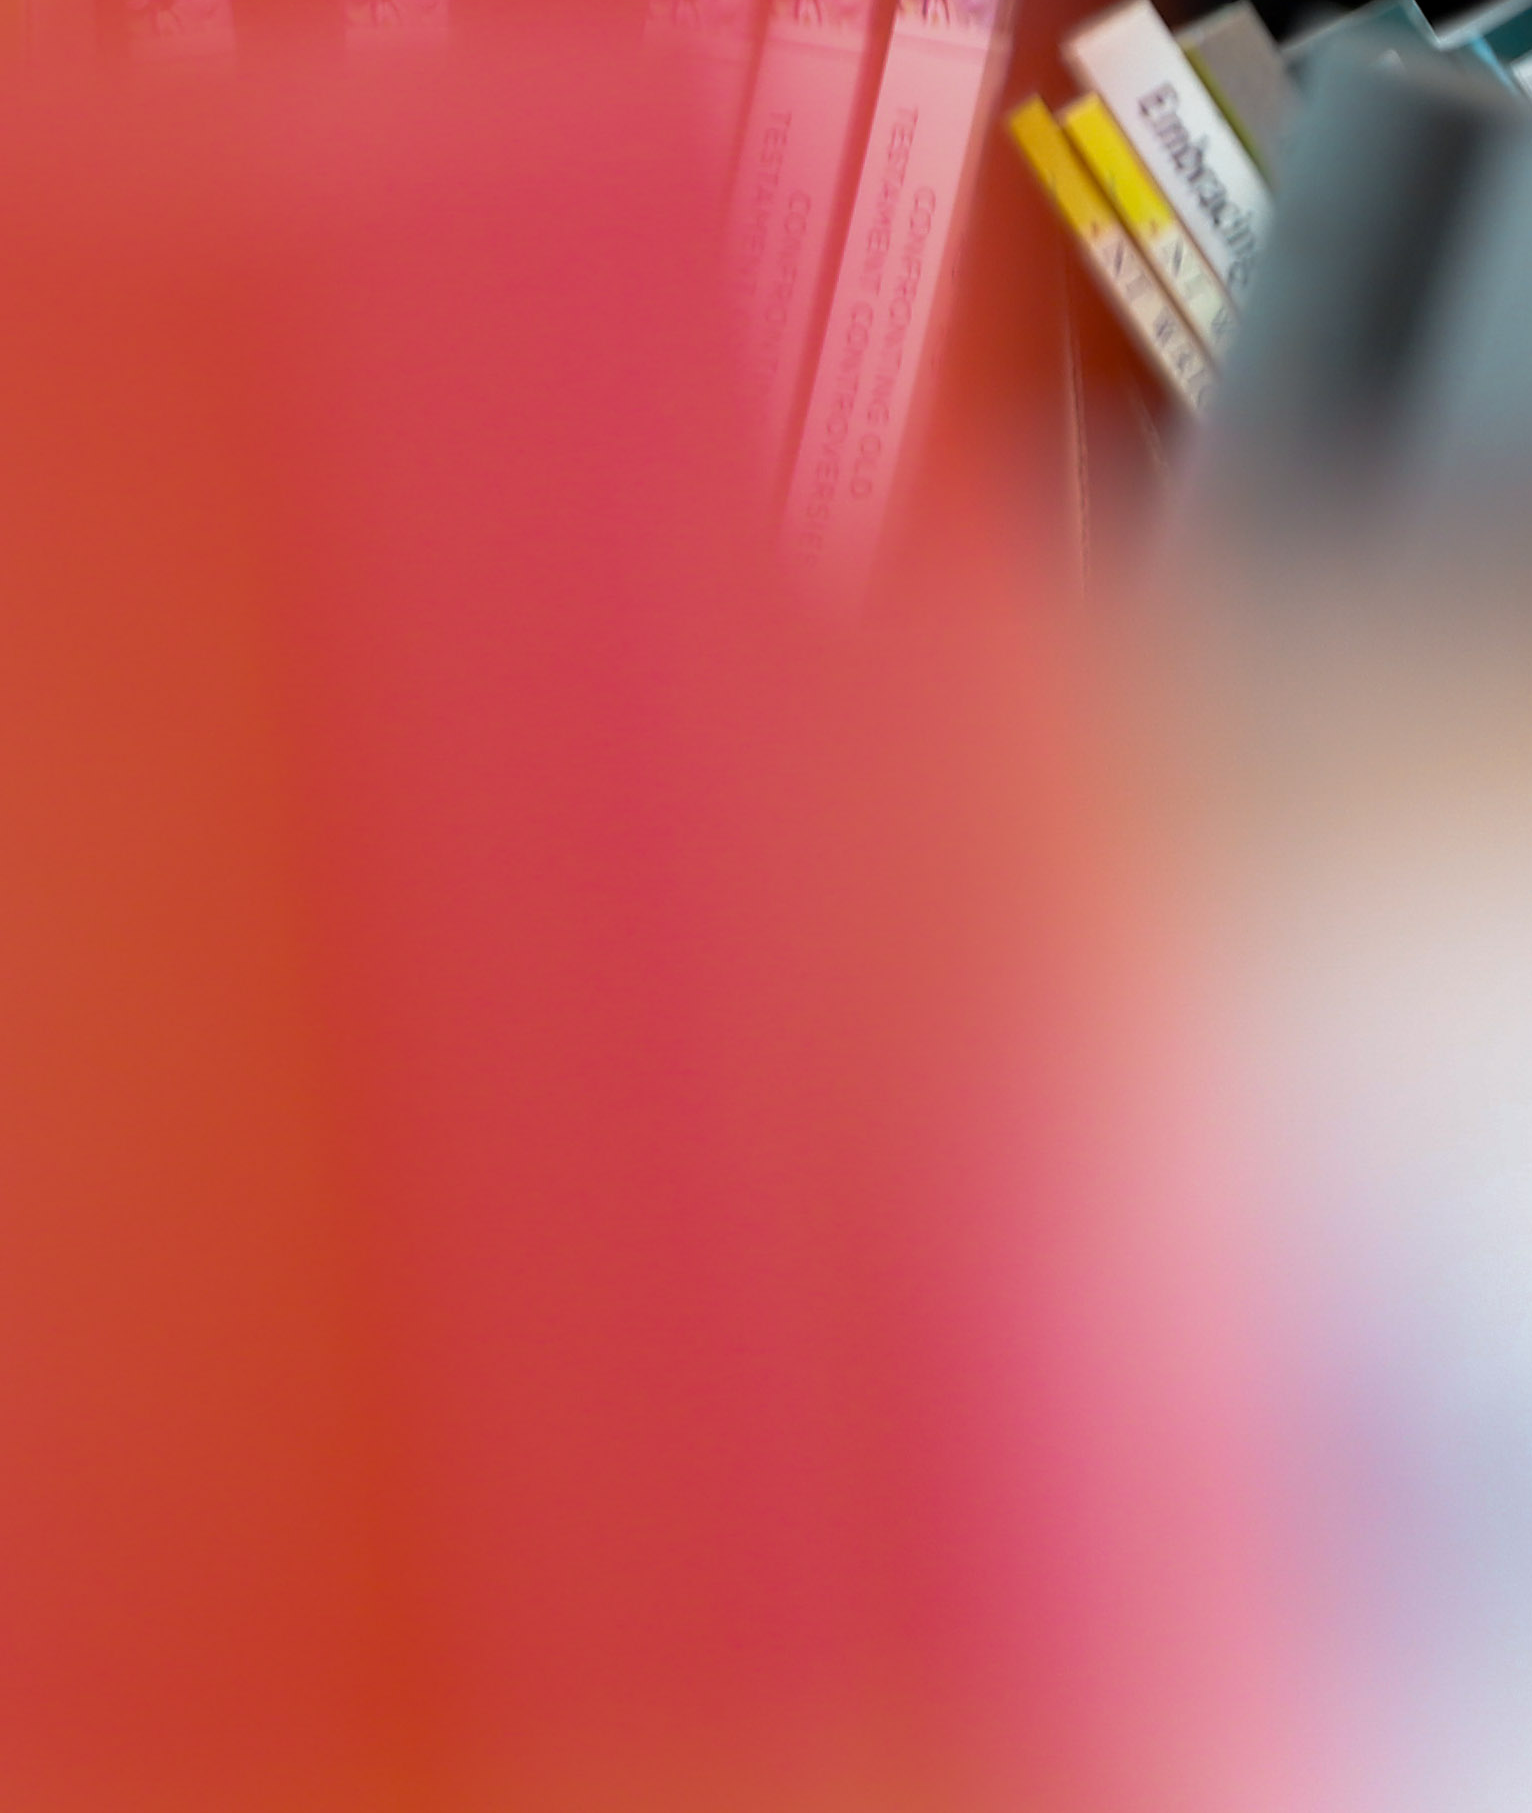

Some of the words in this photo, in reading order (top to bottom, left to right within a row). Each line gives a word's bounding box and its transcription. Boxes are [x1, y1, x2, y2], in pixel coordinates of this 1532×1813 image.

[858, 107, 919, 298] TESTAMENT
[1137, 80, 1259, 290] Embracing
[866, 187, 936, 424] CONFRONTING
[849, 433, 881, 499] OLD
